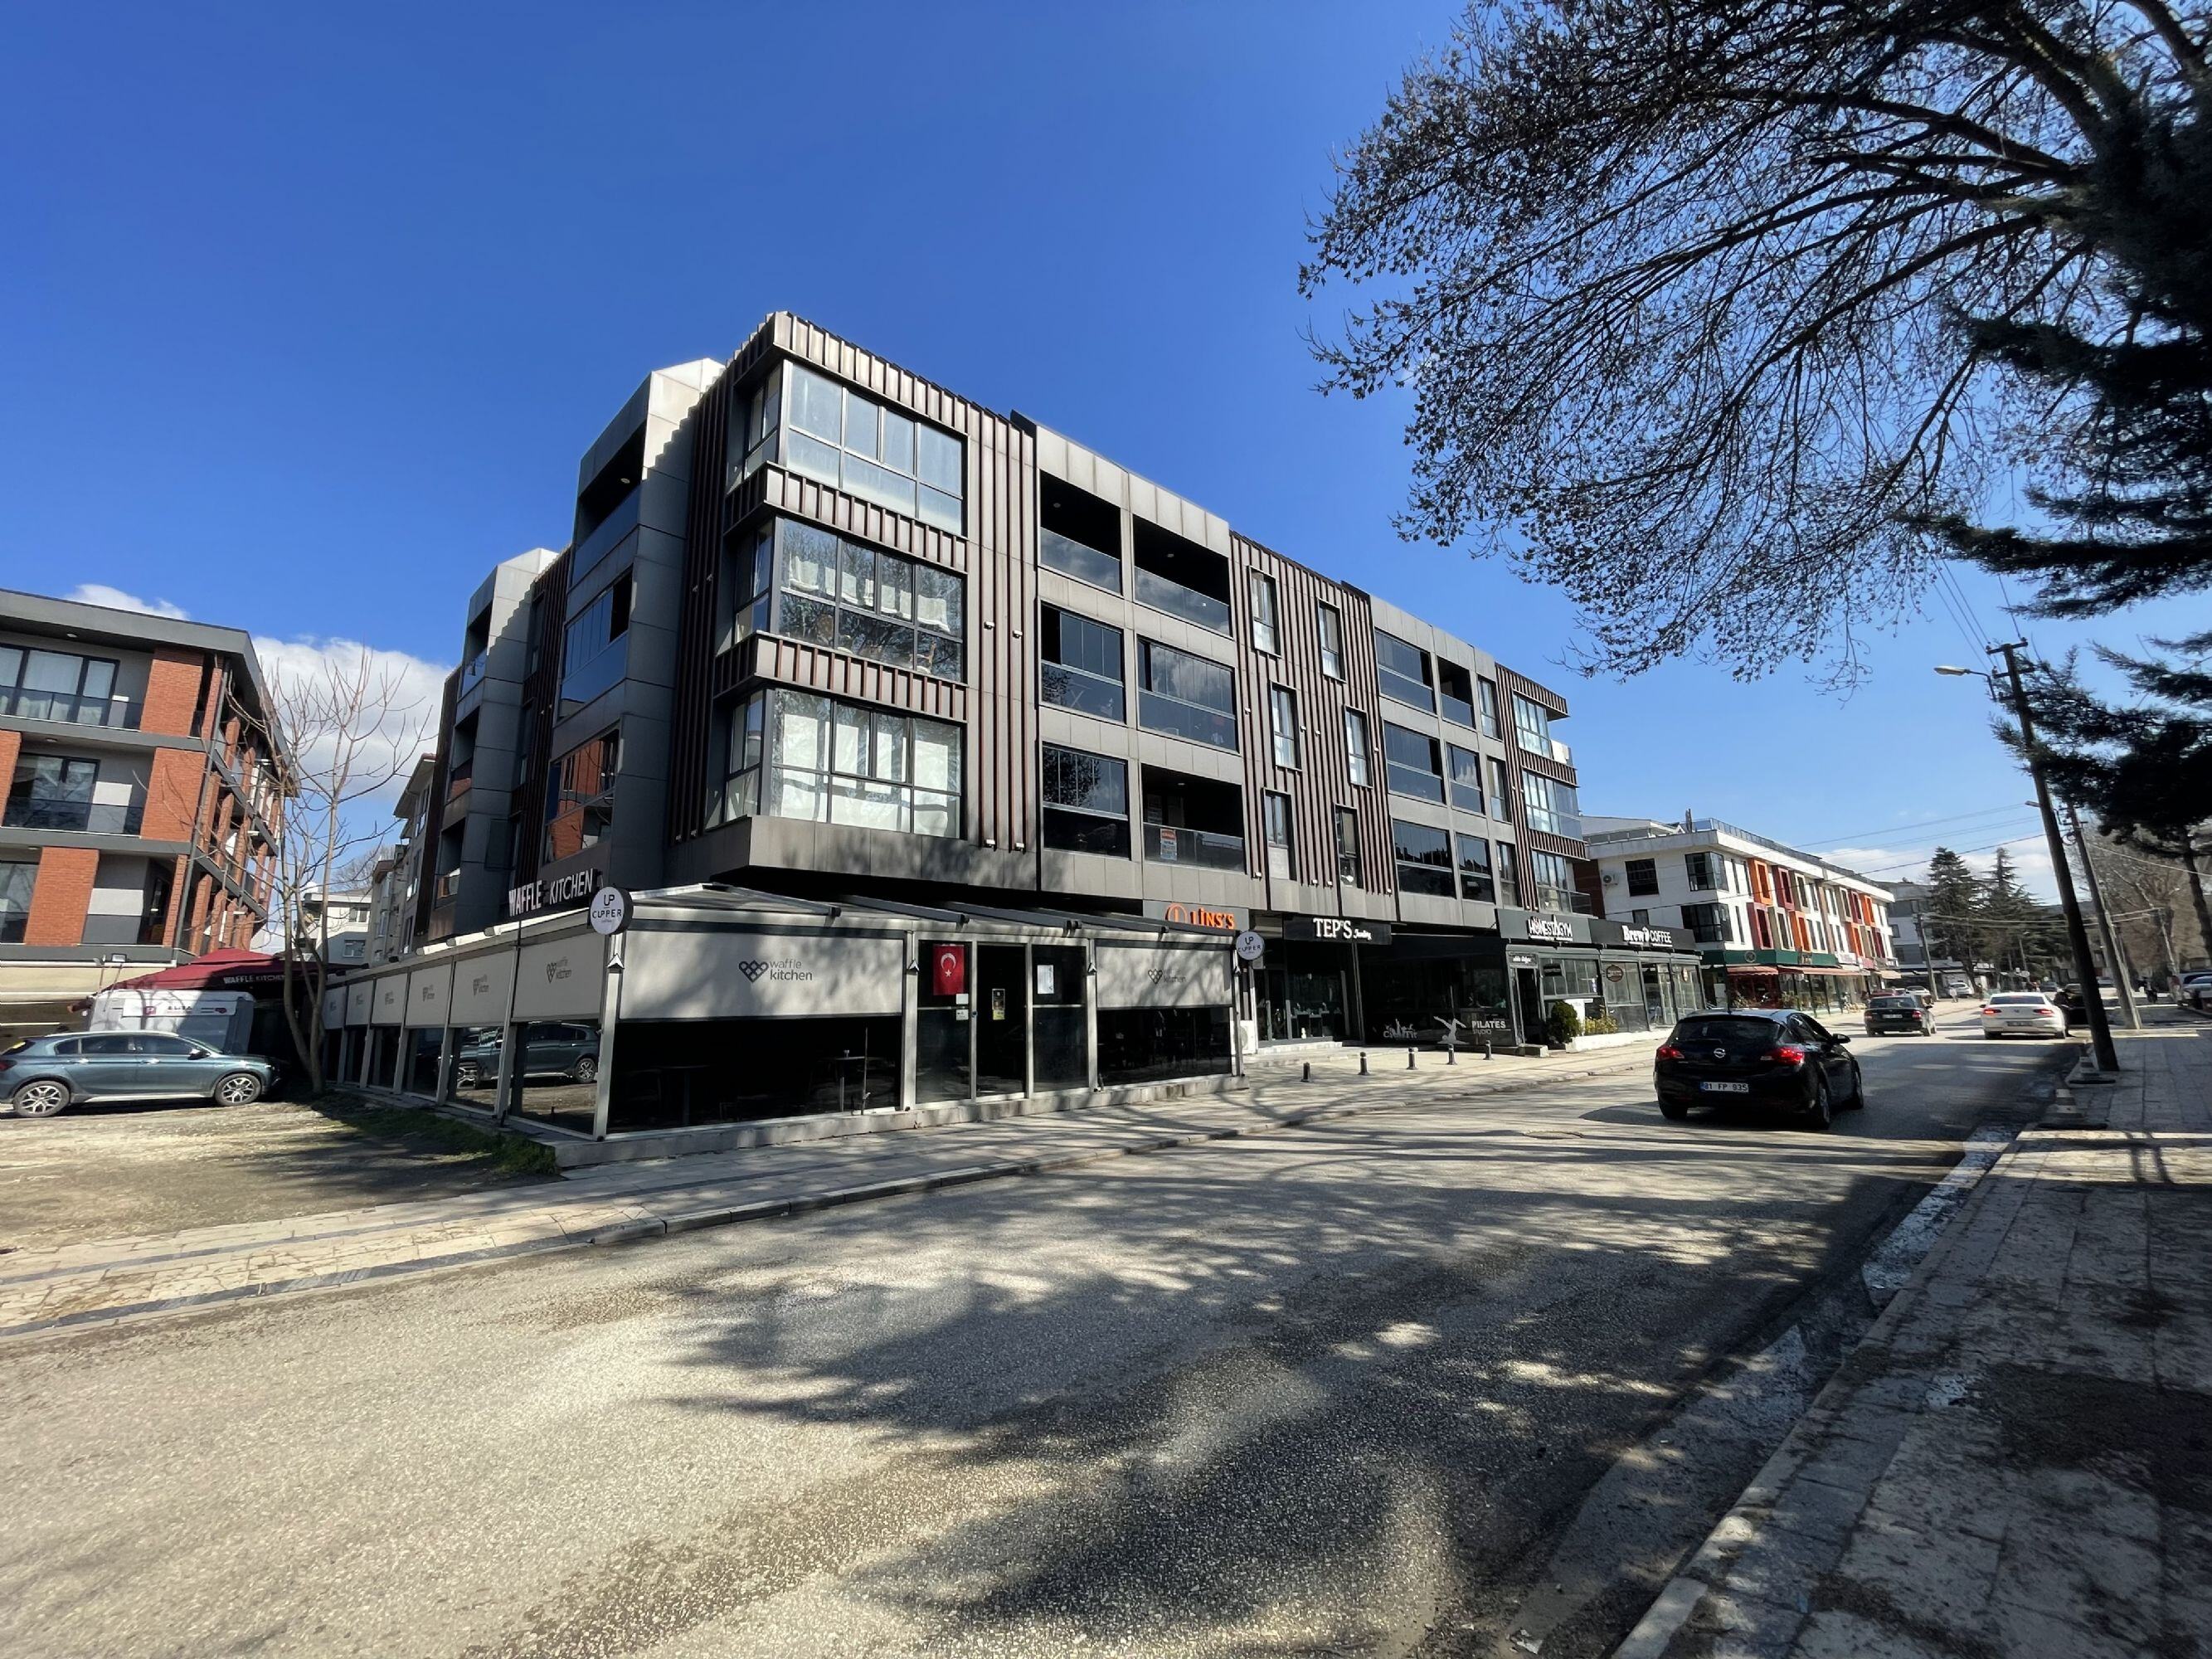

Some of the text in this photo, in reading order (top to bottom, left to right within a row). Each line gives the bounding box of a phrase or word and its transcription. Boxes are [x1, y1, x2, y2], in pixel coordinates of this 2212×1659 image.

[508, 868, 595, 917] WAFFLE KITCHEN
[591, 908, 622, 919] CUPPER
[1313, 917, 1353, 939] TEP'S
[1650, 930, 1672, 944] COFFEE
[770, 958, 802, 969] waffle
[223, 975, 254, 985] WAFFLE
[770, 970, 813, 980] kitchen
[1471, 1020, 1506, 1029] PILATES
